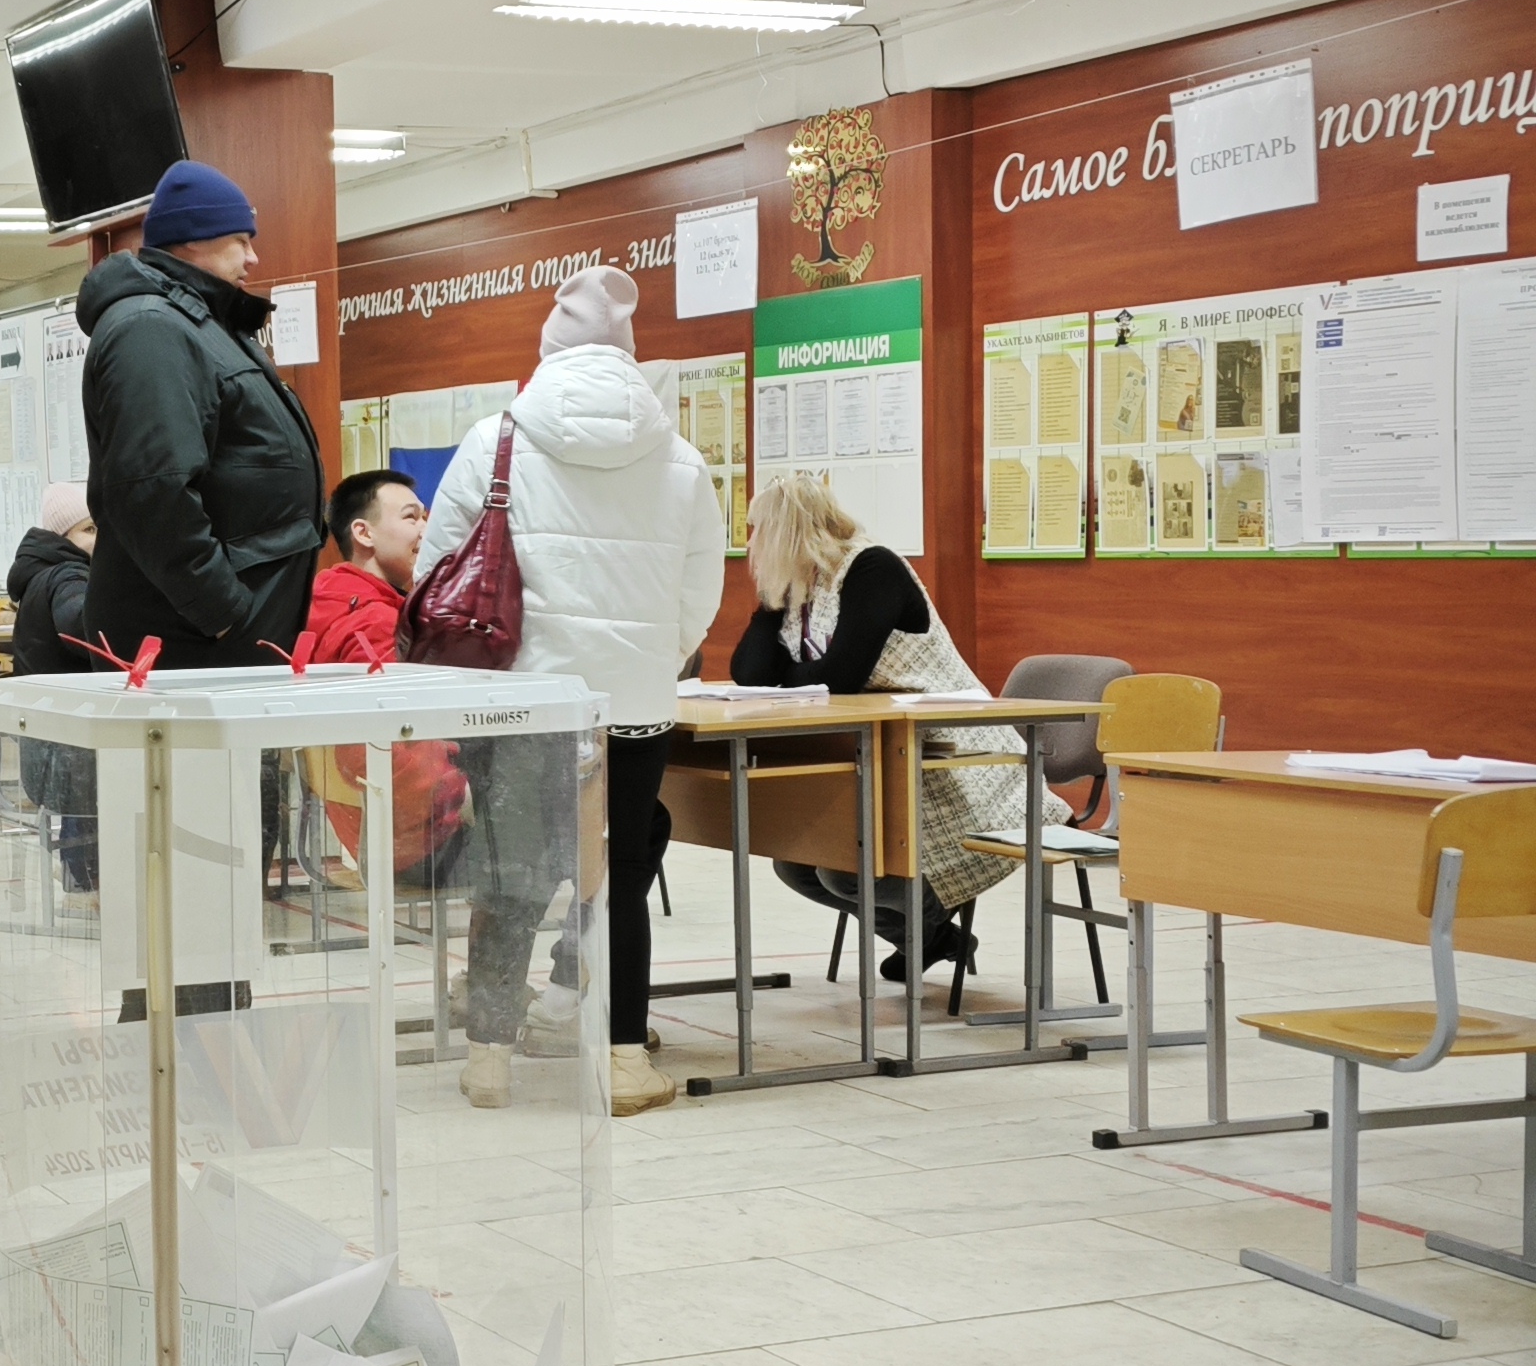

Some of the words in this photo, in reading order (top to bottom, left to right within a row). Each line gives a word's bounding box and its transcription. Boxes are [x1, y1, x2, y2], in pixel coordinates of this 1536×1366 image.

[1190, 136, 1296, 176] СЕКРЕТАРЬ
[993, 146, 1129, 213] Самое
[337, 287, 404, 335] рочная
[407, 263, 525, 319] жизненная
[626, 233, 677, 272] зна
[1158, 319, 1167, 332] Я
[1180, 317, 1189, 329] В
[1193, 311, 1232, 328] МИРЕ
[778, 334, 890, 369] ИНФОРМАЦИЯ
[987, 335, 1033, 349] УКАЗАТЕЛЬ
[1035, 330, 1085, 344] КАБИНЕТОВ
[704, 365, 740, 380] ПОБЕДЫ
[462, 710, 531, 726] 311600557
